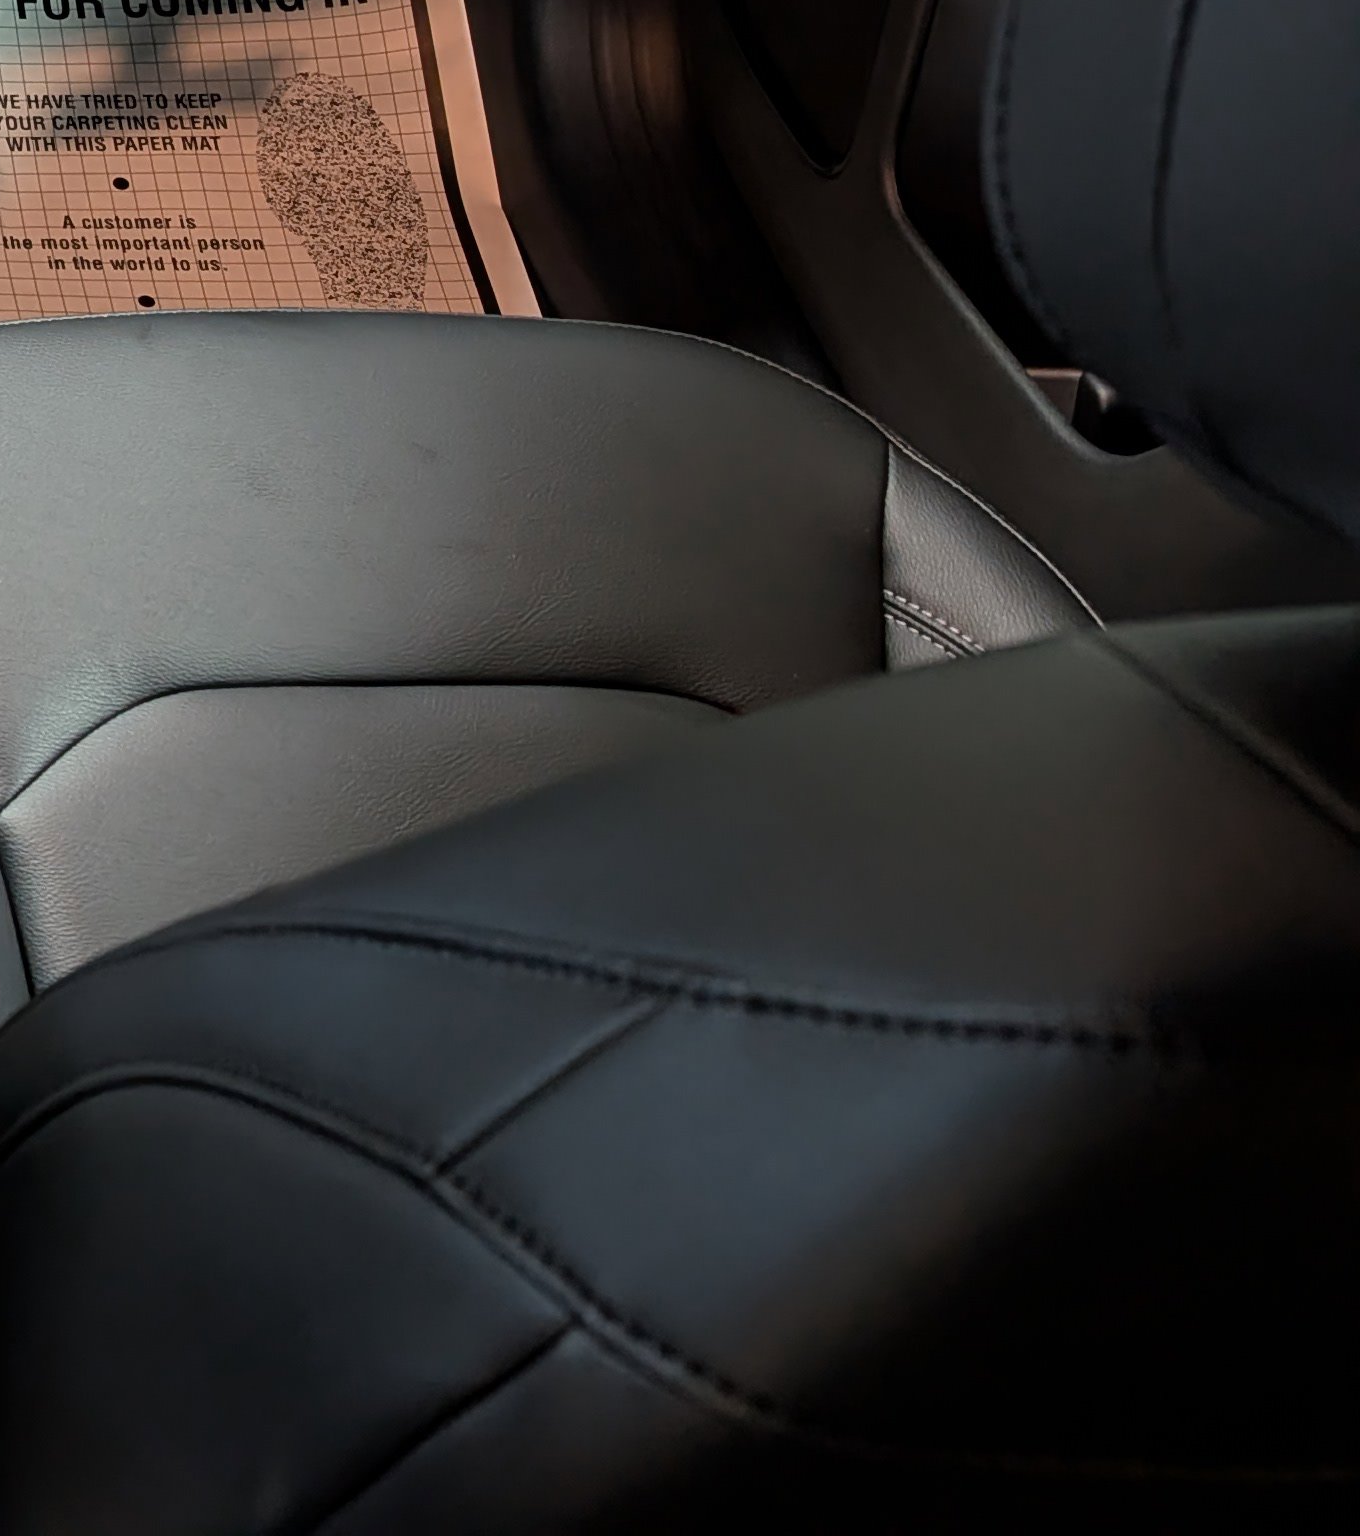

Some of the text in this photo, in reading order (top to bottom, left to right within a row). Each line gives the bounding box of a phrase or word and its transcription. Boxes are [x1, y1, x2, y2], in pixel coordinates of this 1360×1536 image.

[28, 94, 77, 109] HAVE
[83, 94, 137, 109] TRIED
[143, 94, 168, 109] TO
[174, 93, 222, 109] KEEP
[52, 115, 160, 131] CARPETING
[166, 115, 228, 131] CLEAN
[6, 136, 221, 152] WITH THIS PAPER MAT
[63, 214, 197, 229] A customer is
[2, 235, 265, 255] the most important person
[47, 256, 228, 271] in the world to us.
